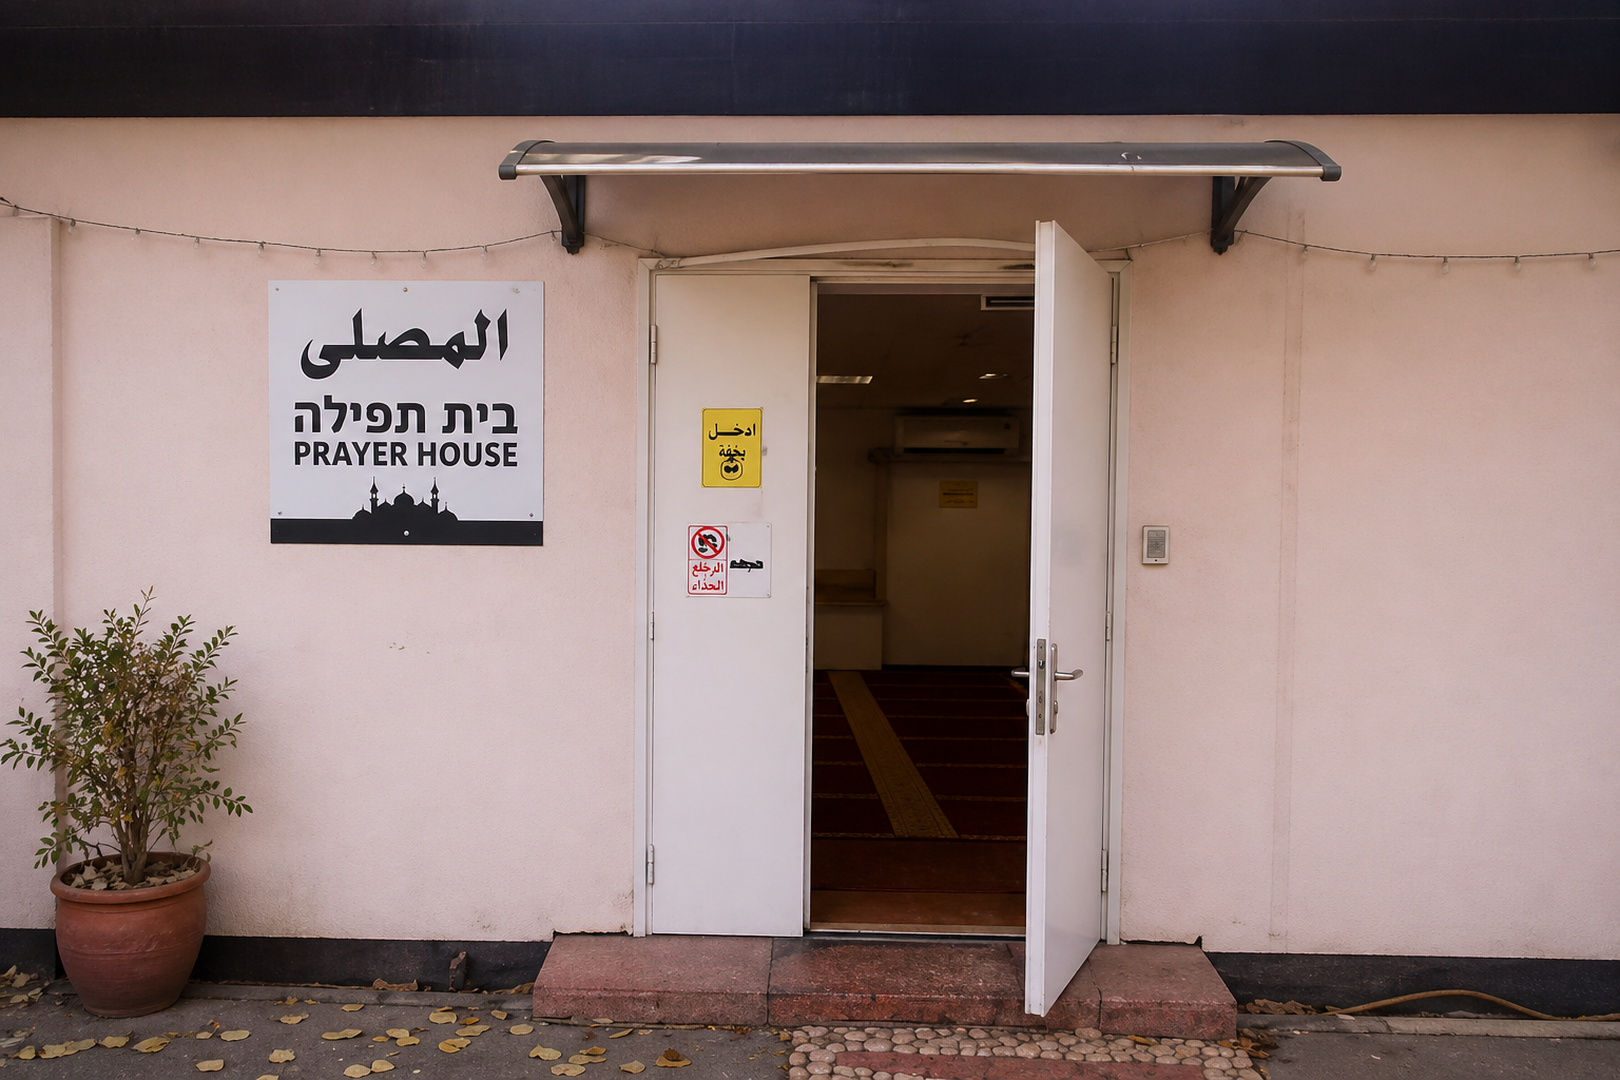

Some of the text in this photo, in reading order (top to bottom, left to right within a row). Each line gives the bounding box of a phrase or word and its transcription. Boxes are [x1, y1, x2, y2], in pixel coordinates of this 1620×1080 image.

[300, 307, 508, 380] المصلى
[294, 395, 518, 434] בית תפילה
[294, 441, 518, 467] PRAYER HOUSE
